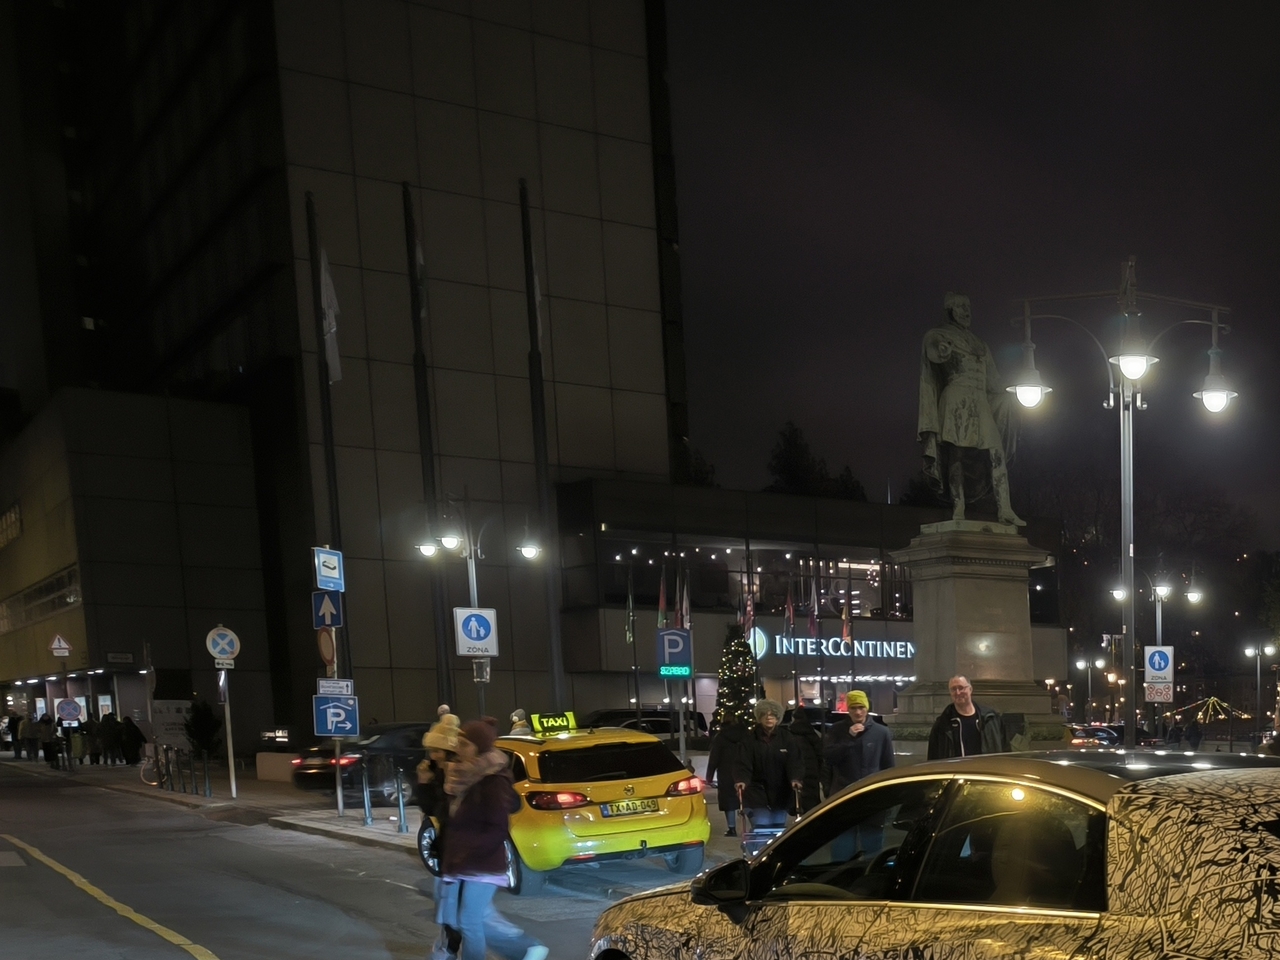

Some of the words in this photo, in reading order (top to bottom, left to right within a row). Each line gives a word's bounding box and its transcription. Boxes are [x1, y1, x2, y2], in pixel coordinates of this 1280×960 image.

[664, 635, 684, 664] P
[660, 666, 690, 675] SZABAD
[327, 708, 345, 730] P
[541, 717, 567, 727] TAXI
[609, 804, 622, 813] TX
